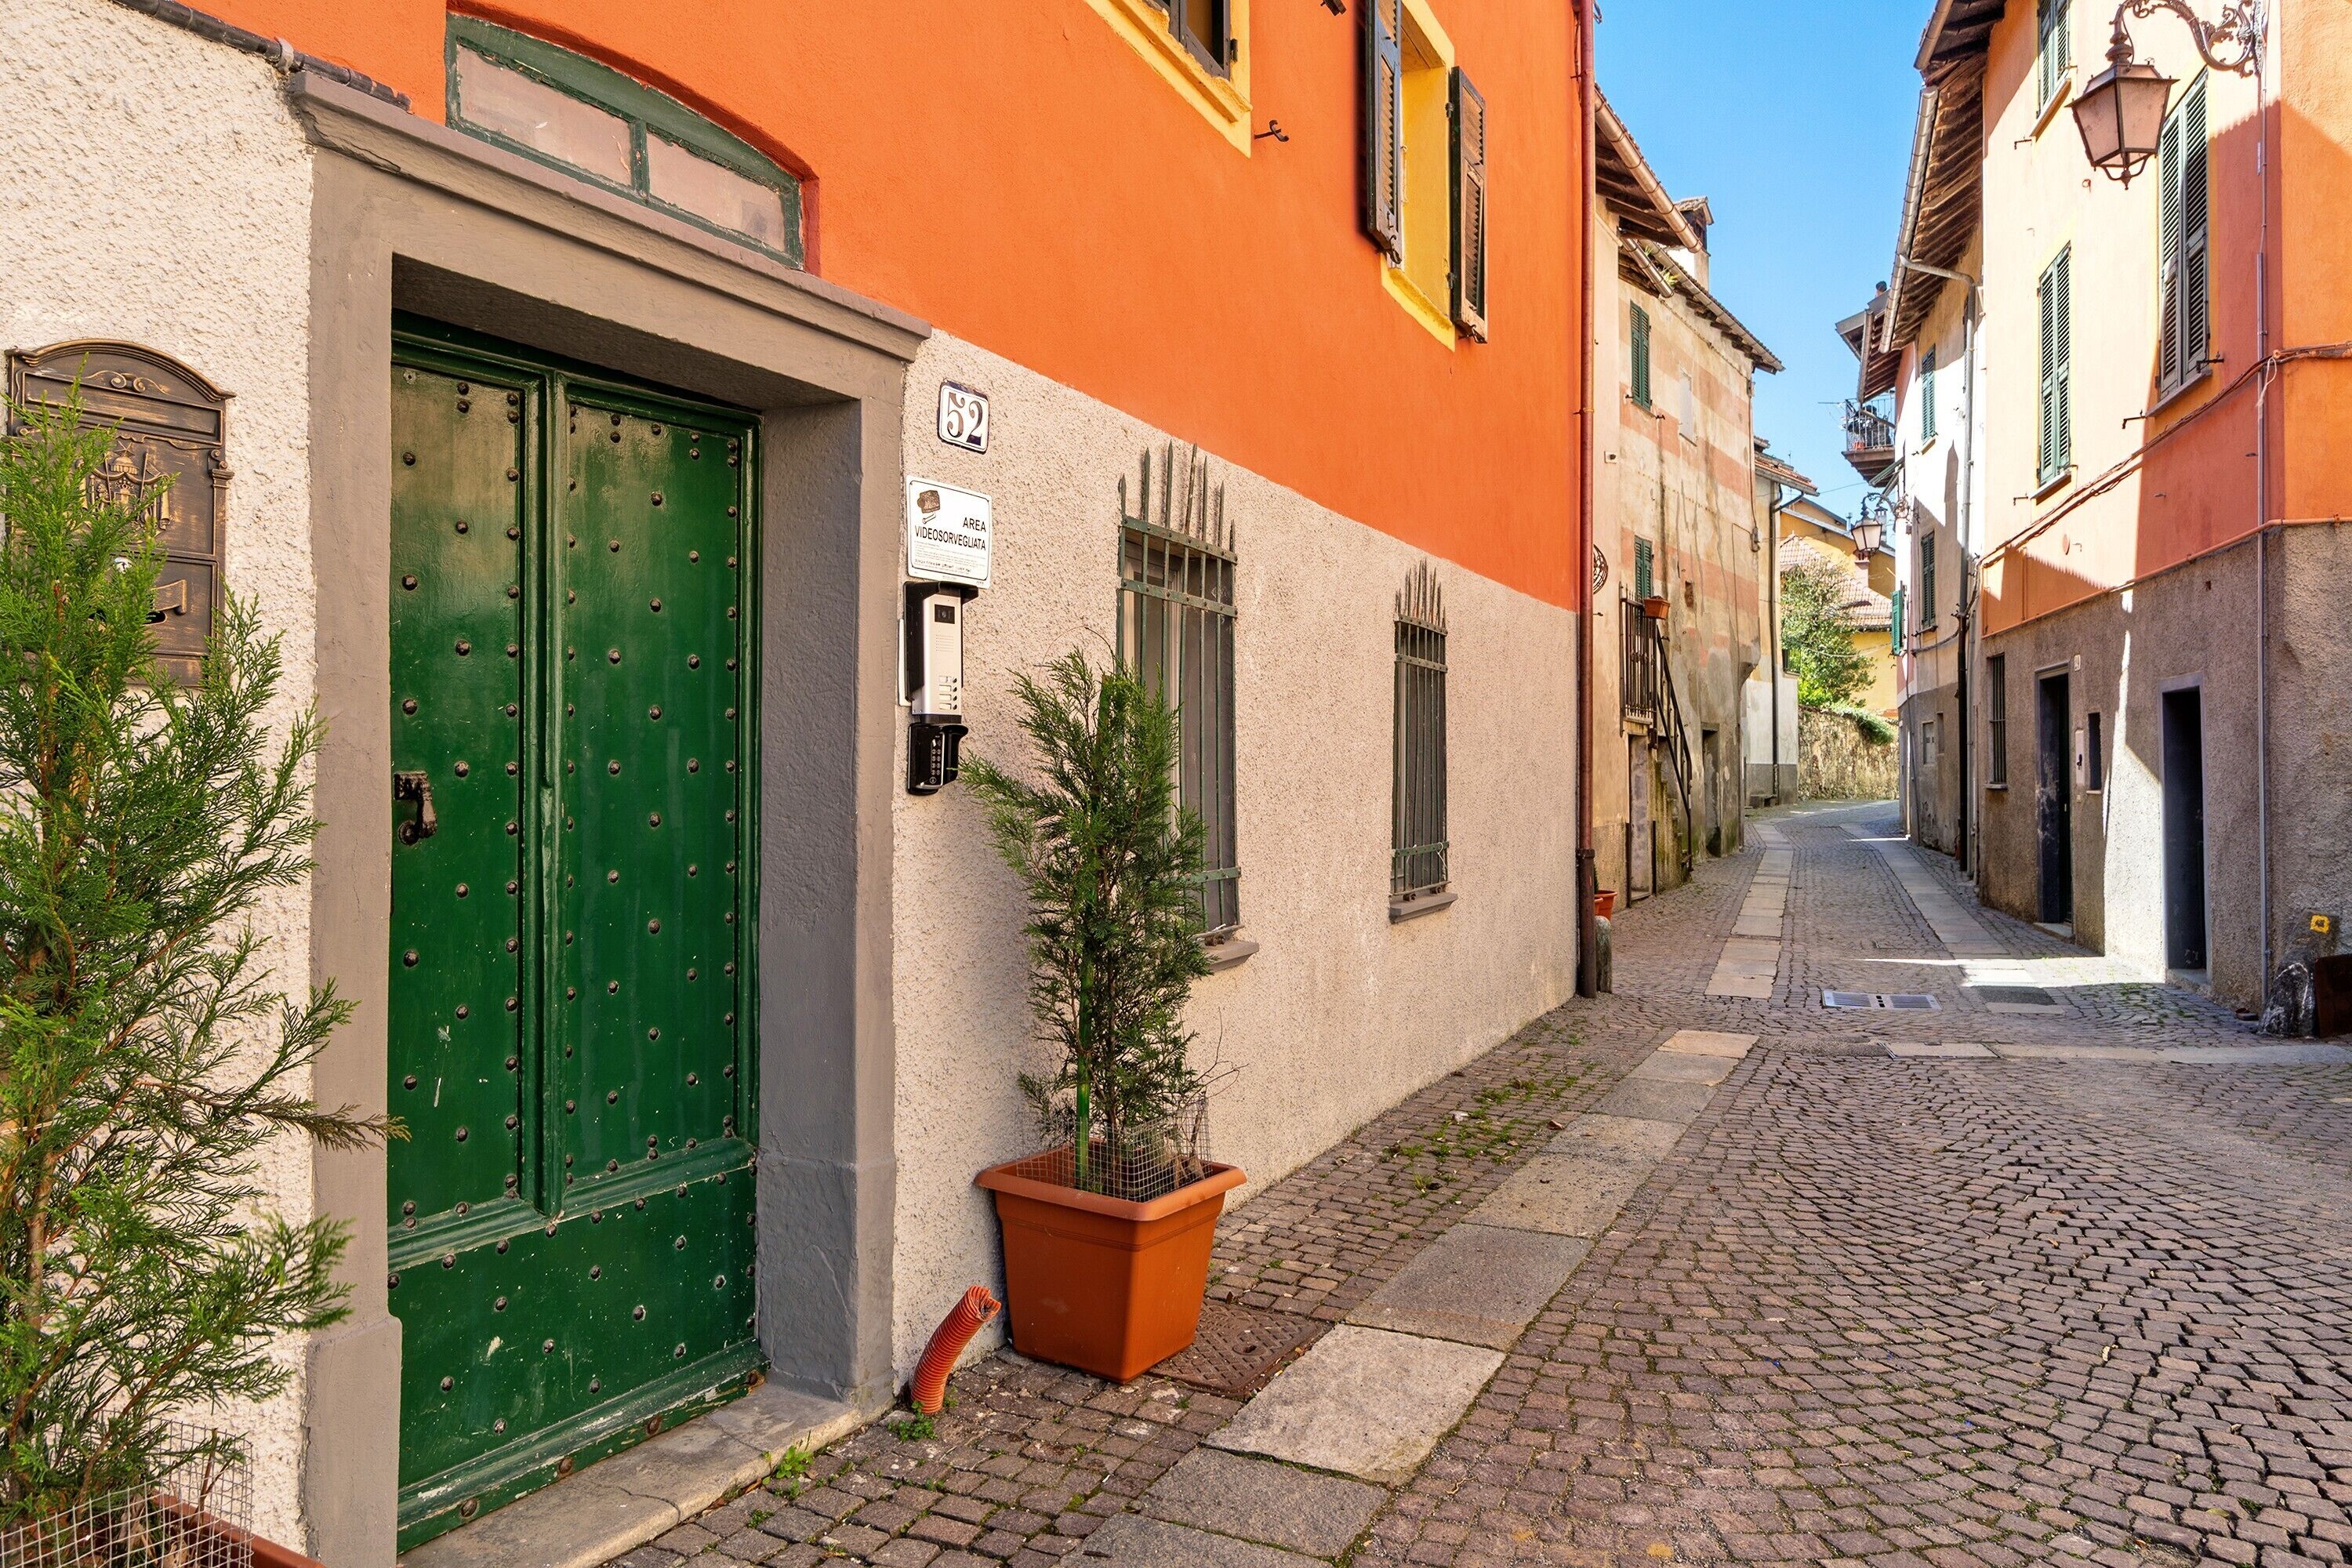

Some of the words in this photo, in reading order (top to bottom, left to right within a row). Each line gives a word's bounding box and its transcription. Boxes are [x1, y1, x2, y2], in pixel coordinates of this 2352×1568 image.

[947, 392, 982, 446] 52
[963, 517, 986, 532] AREA
[915, 525, 986, 551] VIDEOSORVEGLIATA
